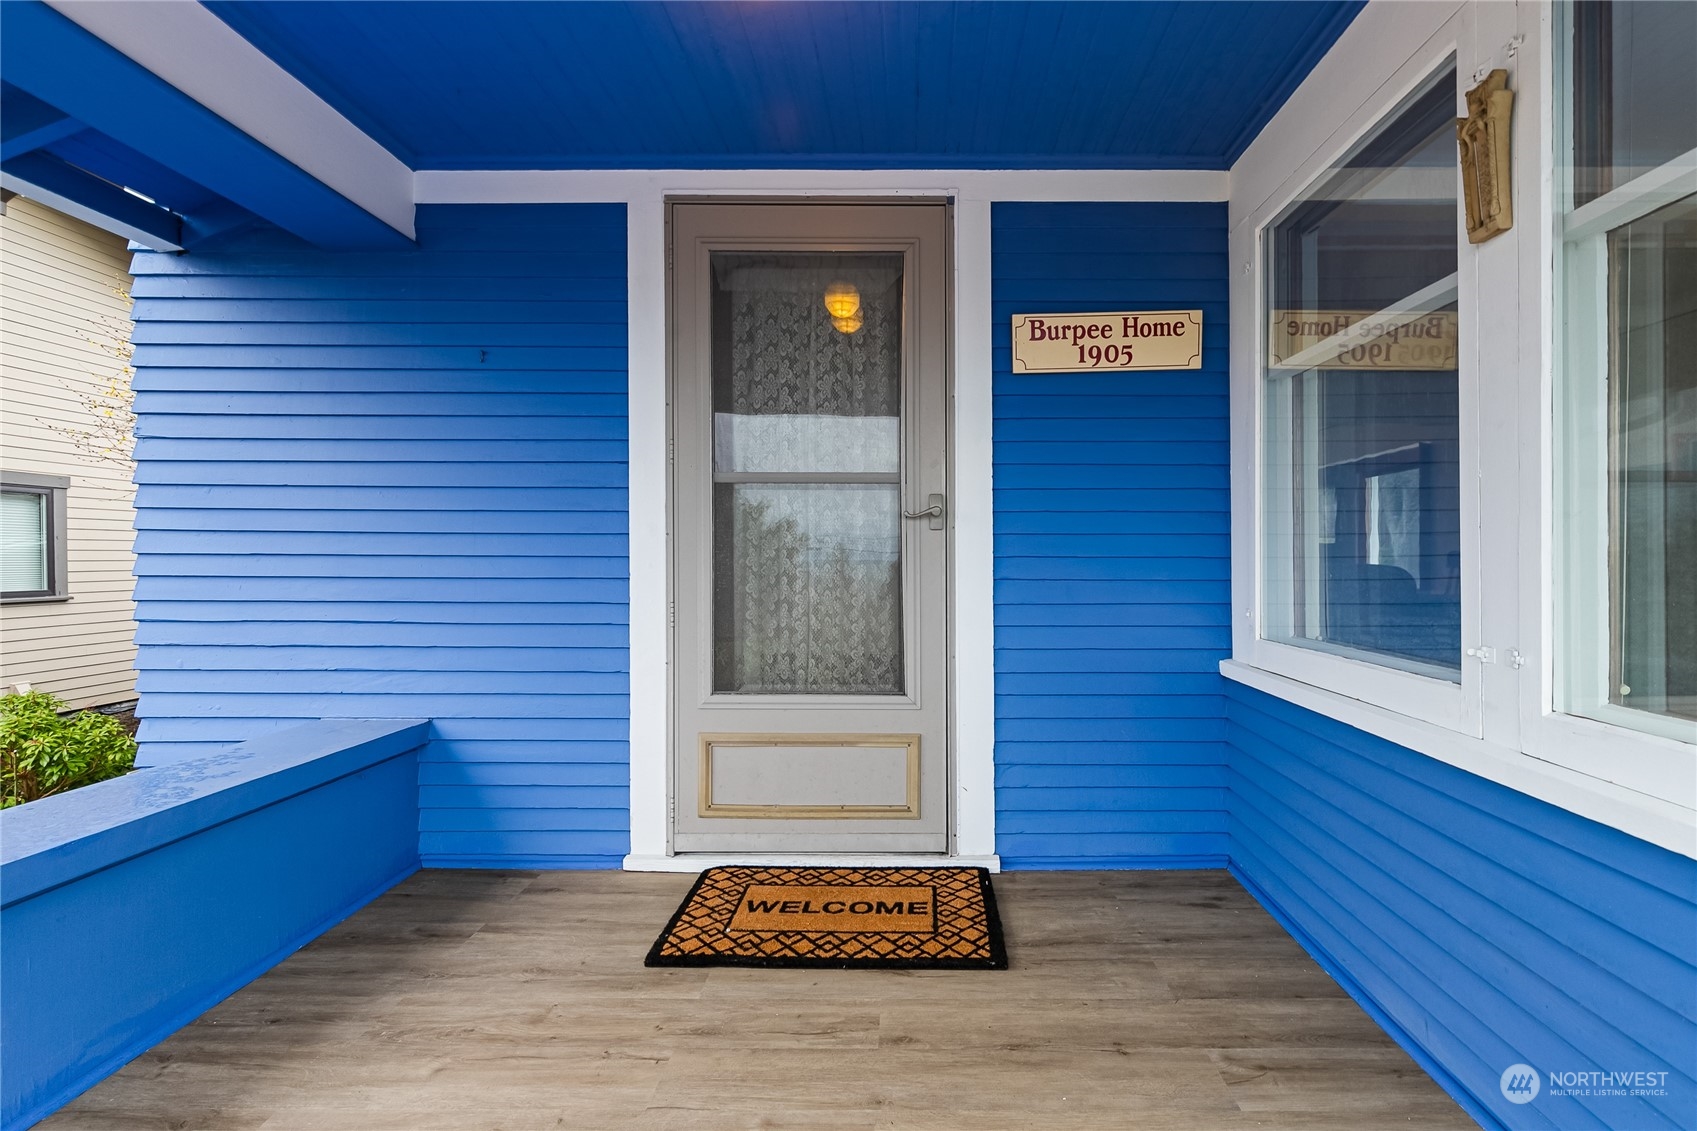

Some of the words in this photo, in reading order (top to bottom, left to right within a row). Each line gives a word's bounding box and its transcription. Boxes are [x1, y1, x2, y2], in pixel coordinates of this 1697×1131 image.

[1028, 319, 1113, 346] Burpee
[1121, 316, 1186, 338] Home
[1078, 344, 1134, 367] 1905
[746, 900, 929, 915] WELCOME
